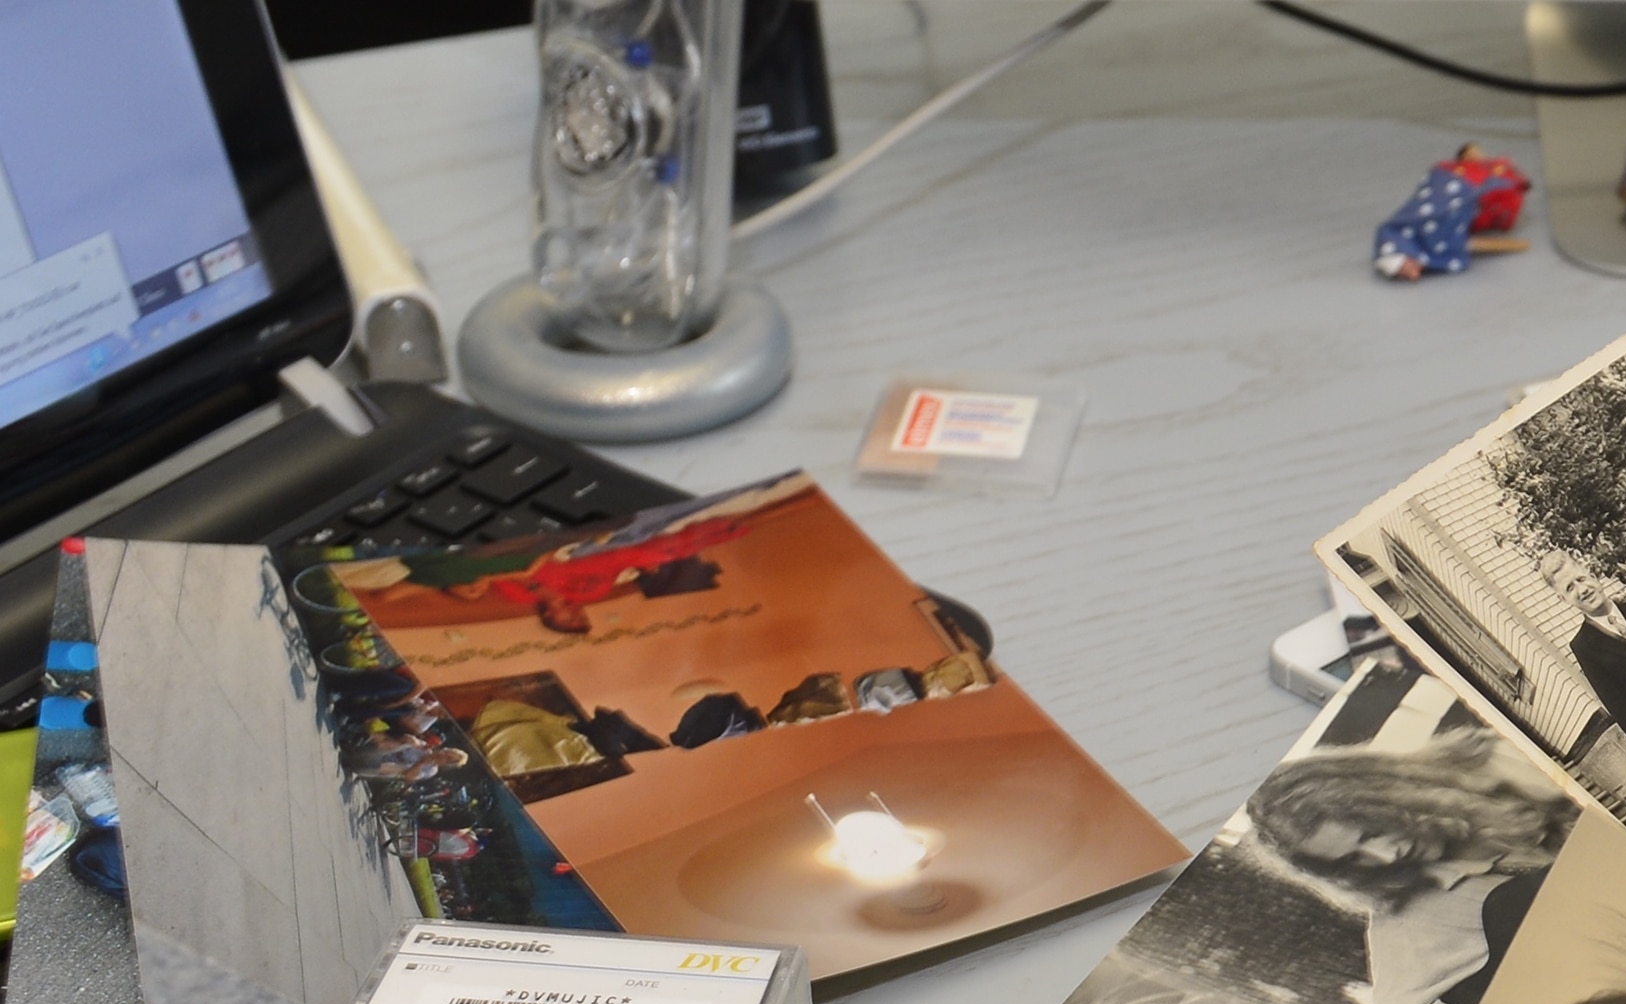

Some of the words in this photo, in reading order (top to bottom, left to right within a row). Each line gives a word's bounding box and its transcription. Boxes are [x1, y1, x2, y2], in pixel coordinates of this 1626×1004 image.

[414, 931, 553, 954] Panasonic
[417, 963, 453, 973] TITLE
[677, 952, 760, 973] DVC
[624, 978, 661, 989] DATE
